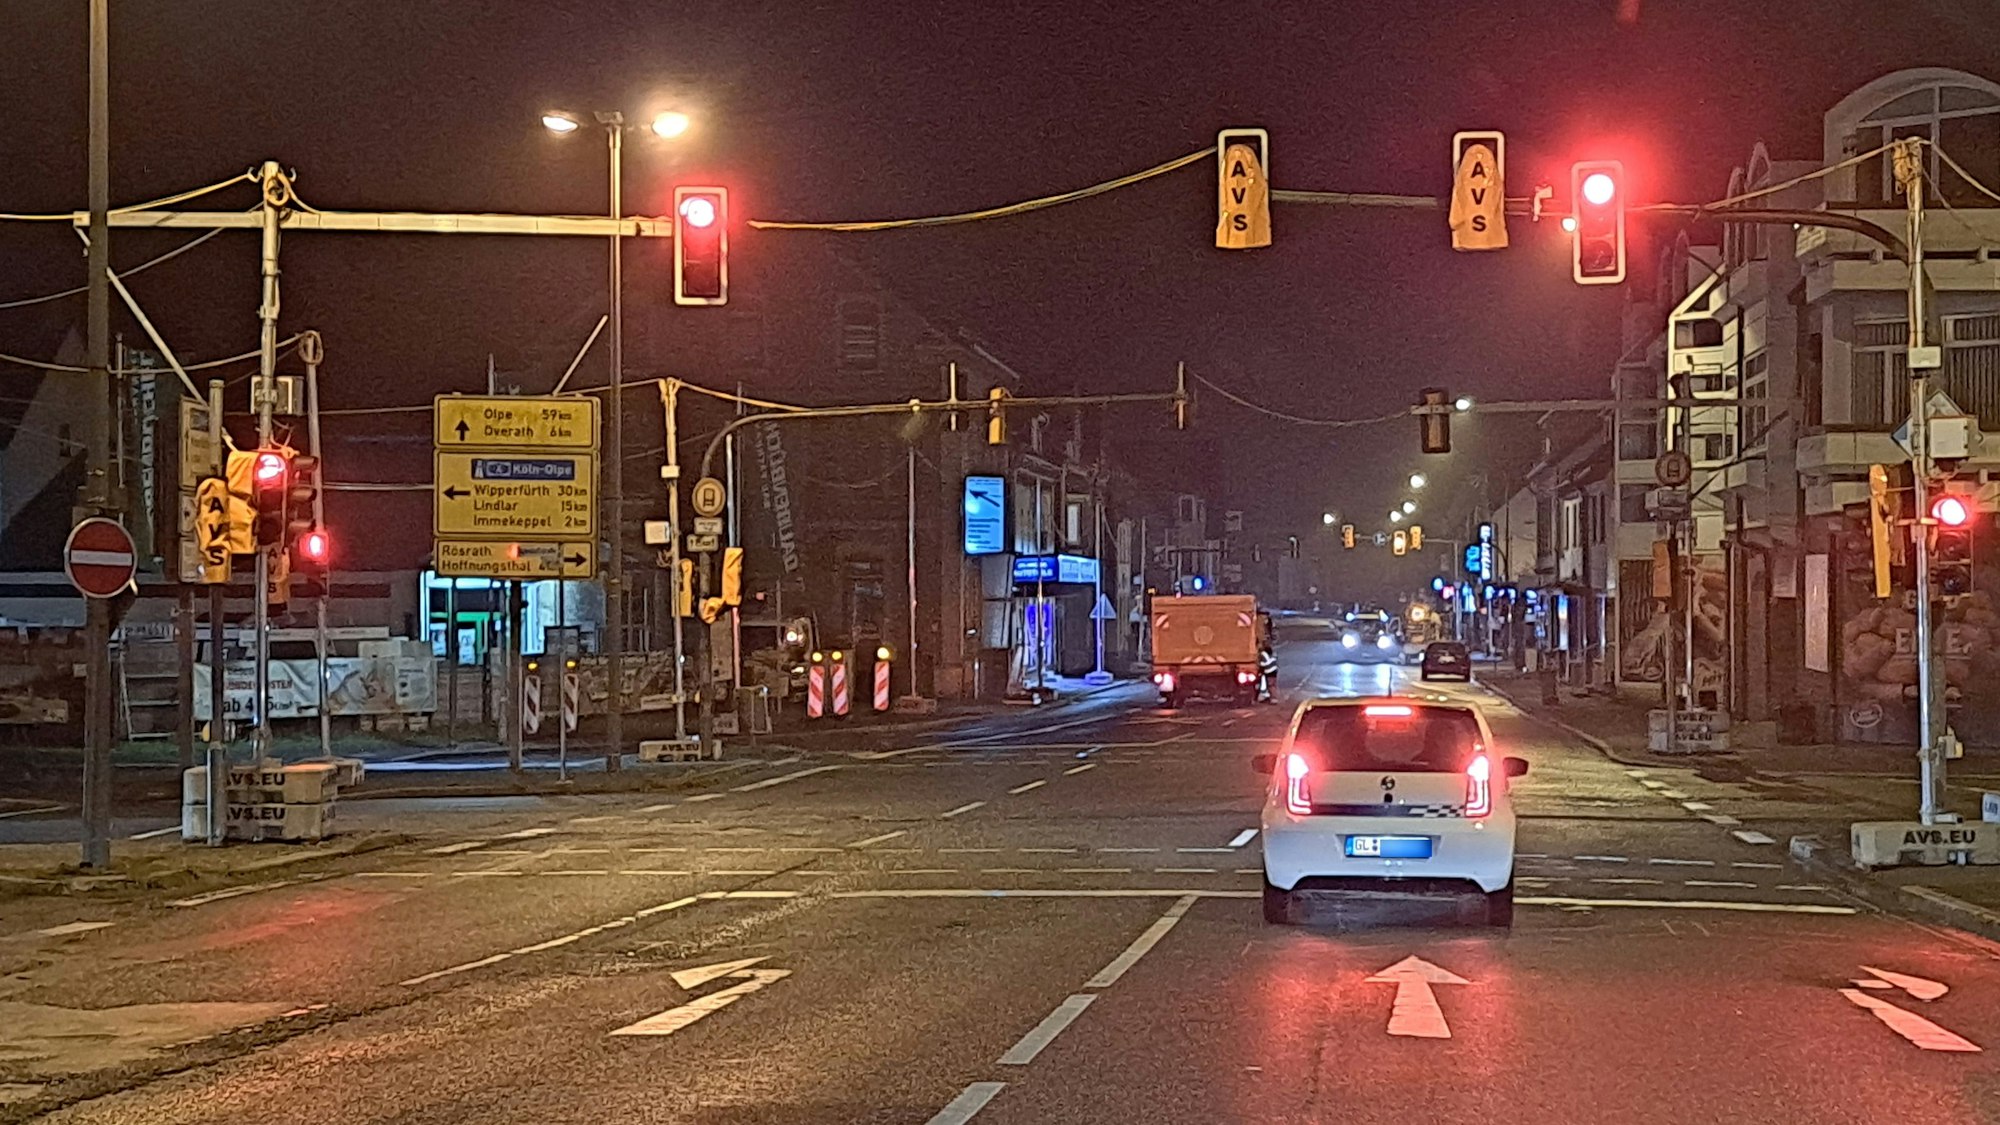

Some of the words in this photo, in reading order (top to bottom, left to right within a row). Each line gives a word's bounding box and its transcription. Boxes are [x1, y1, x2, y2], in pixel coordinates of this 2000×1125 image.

[1231, 160, 1248, 231] AVS
[1471, 161, 1487, 232] AVS
[484, 408, 513, 421] Olpe
[484, 425, 534, 437] Overath
[512, 463, 573, 478] Köln-Olpe
[474, 484, 550, 497] Wipperfürth
[474, 500, 519, 511] Lindlar
[474, 515, 552, 528] Immekeppel
[207, 497, 225, 566] AVS
[442, 545, 492, 557] Rösrath
[442, 560, 531, 573] Hoffnungsthal
[661, 744, 700, 752] AVS.EU
[227, 807, 286, 820] VS.EU
[1903, 830, 1976, 844] AVS.EU
[1355, 839, 1370, 851] GL
